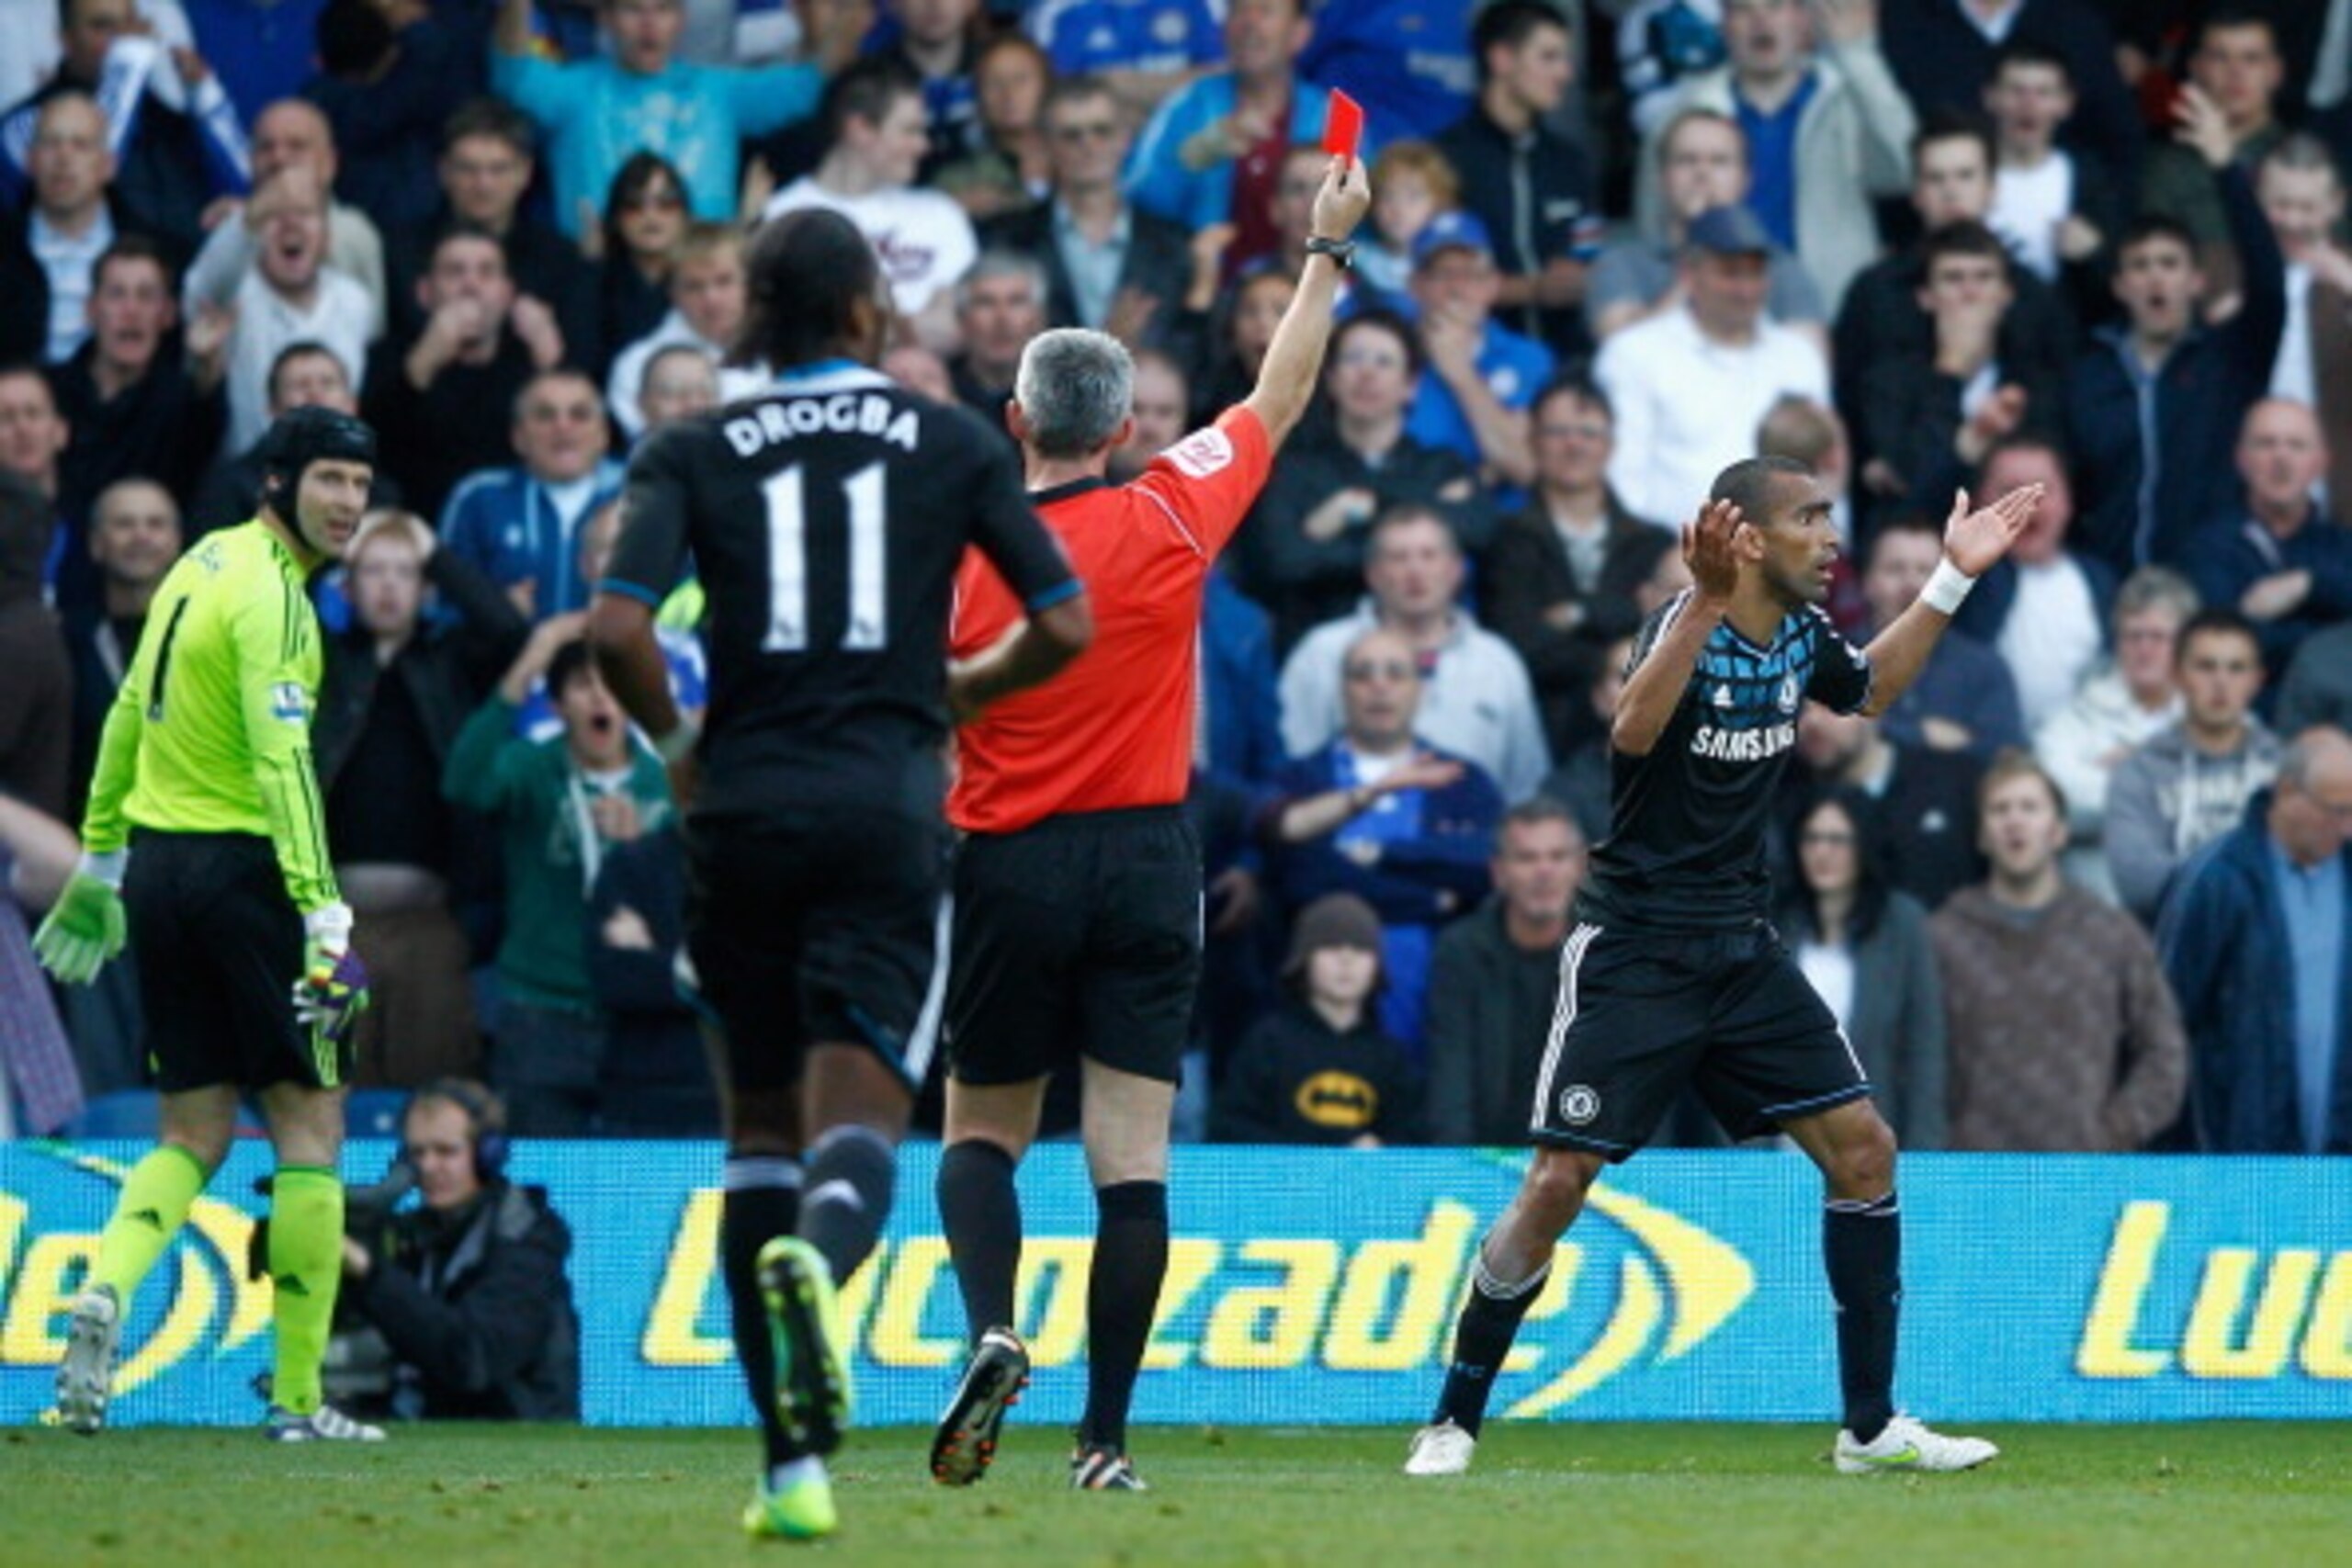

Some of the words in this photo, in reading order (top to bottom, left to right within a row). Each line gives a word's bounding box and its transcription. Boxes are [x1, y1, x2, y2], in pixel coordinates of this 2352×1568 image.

[723, 394, 919, 457] DROGBA
[761, 461, 888, 651] 11
[147, 592, 191, 722] 1
[642, 1188, 1584, 1371] Lcozad
